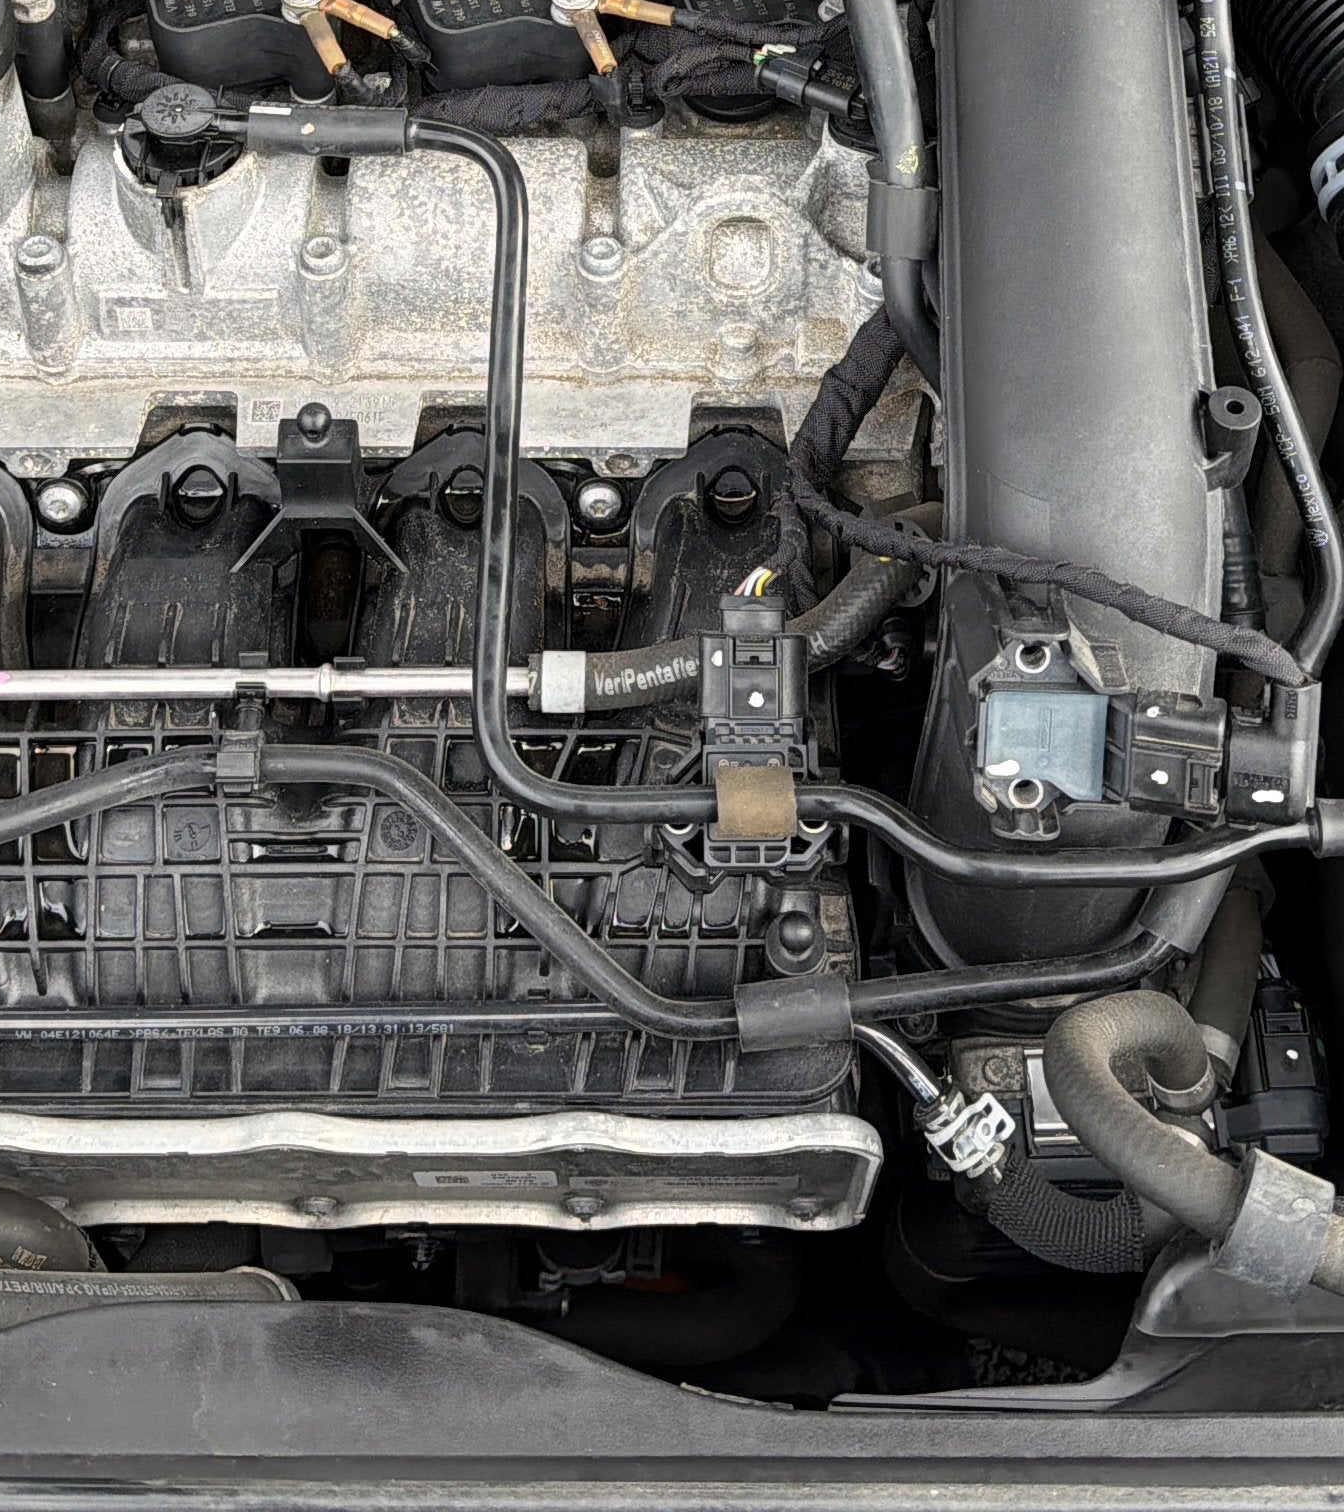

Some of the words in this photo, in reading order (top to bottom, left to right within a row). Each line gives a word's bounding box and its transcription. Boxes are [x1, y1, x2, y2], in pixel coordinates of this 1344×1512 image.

[1201, 16, 1217, 39] 524
[594, 656, 700, 696] VeriPentafle
[176, 1027, 224, 1038] TEKLAS
